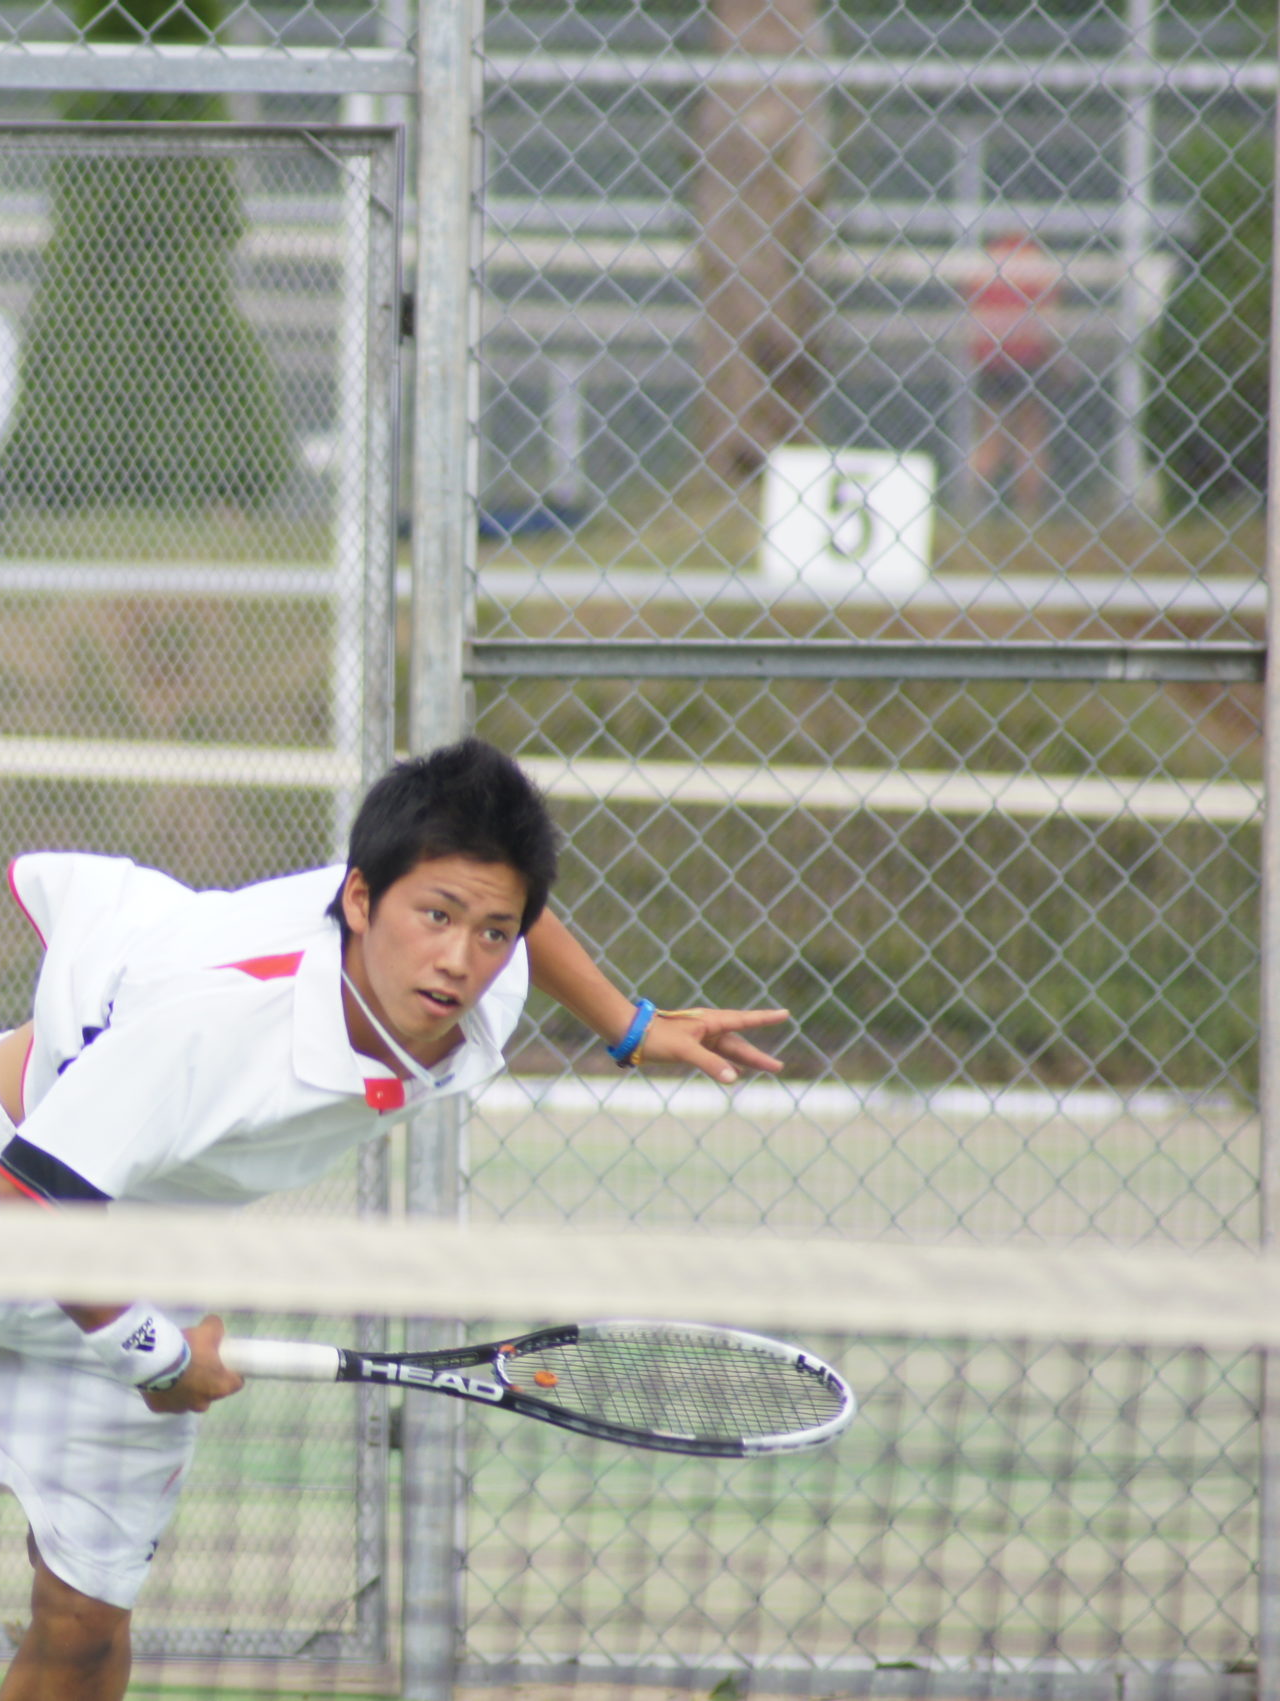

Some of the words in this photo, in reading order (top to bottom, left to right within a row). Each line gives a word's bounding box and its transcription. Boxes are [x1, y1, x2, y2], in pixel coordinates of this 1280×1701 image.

[825, 473, 872, 562] 5
[122, 1317, 153, 1351] adidas
[362, 1359, 504, 1402] HEAD
